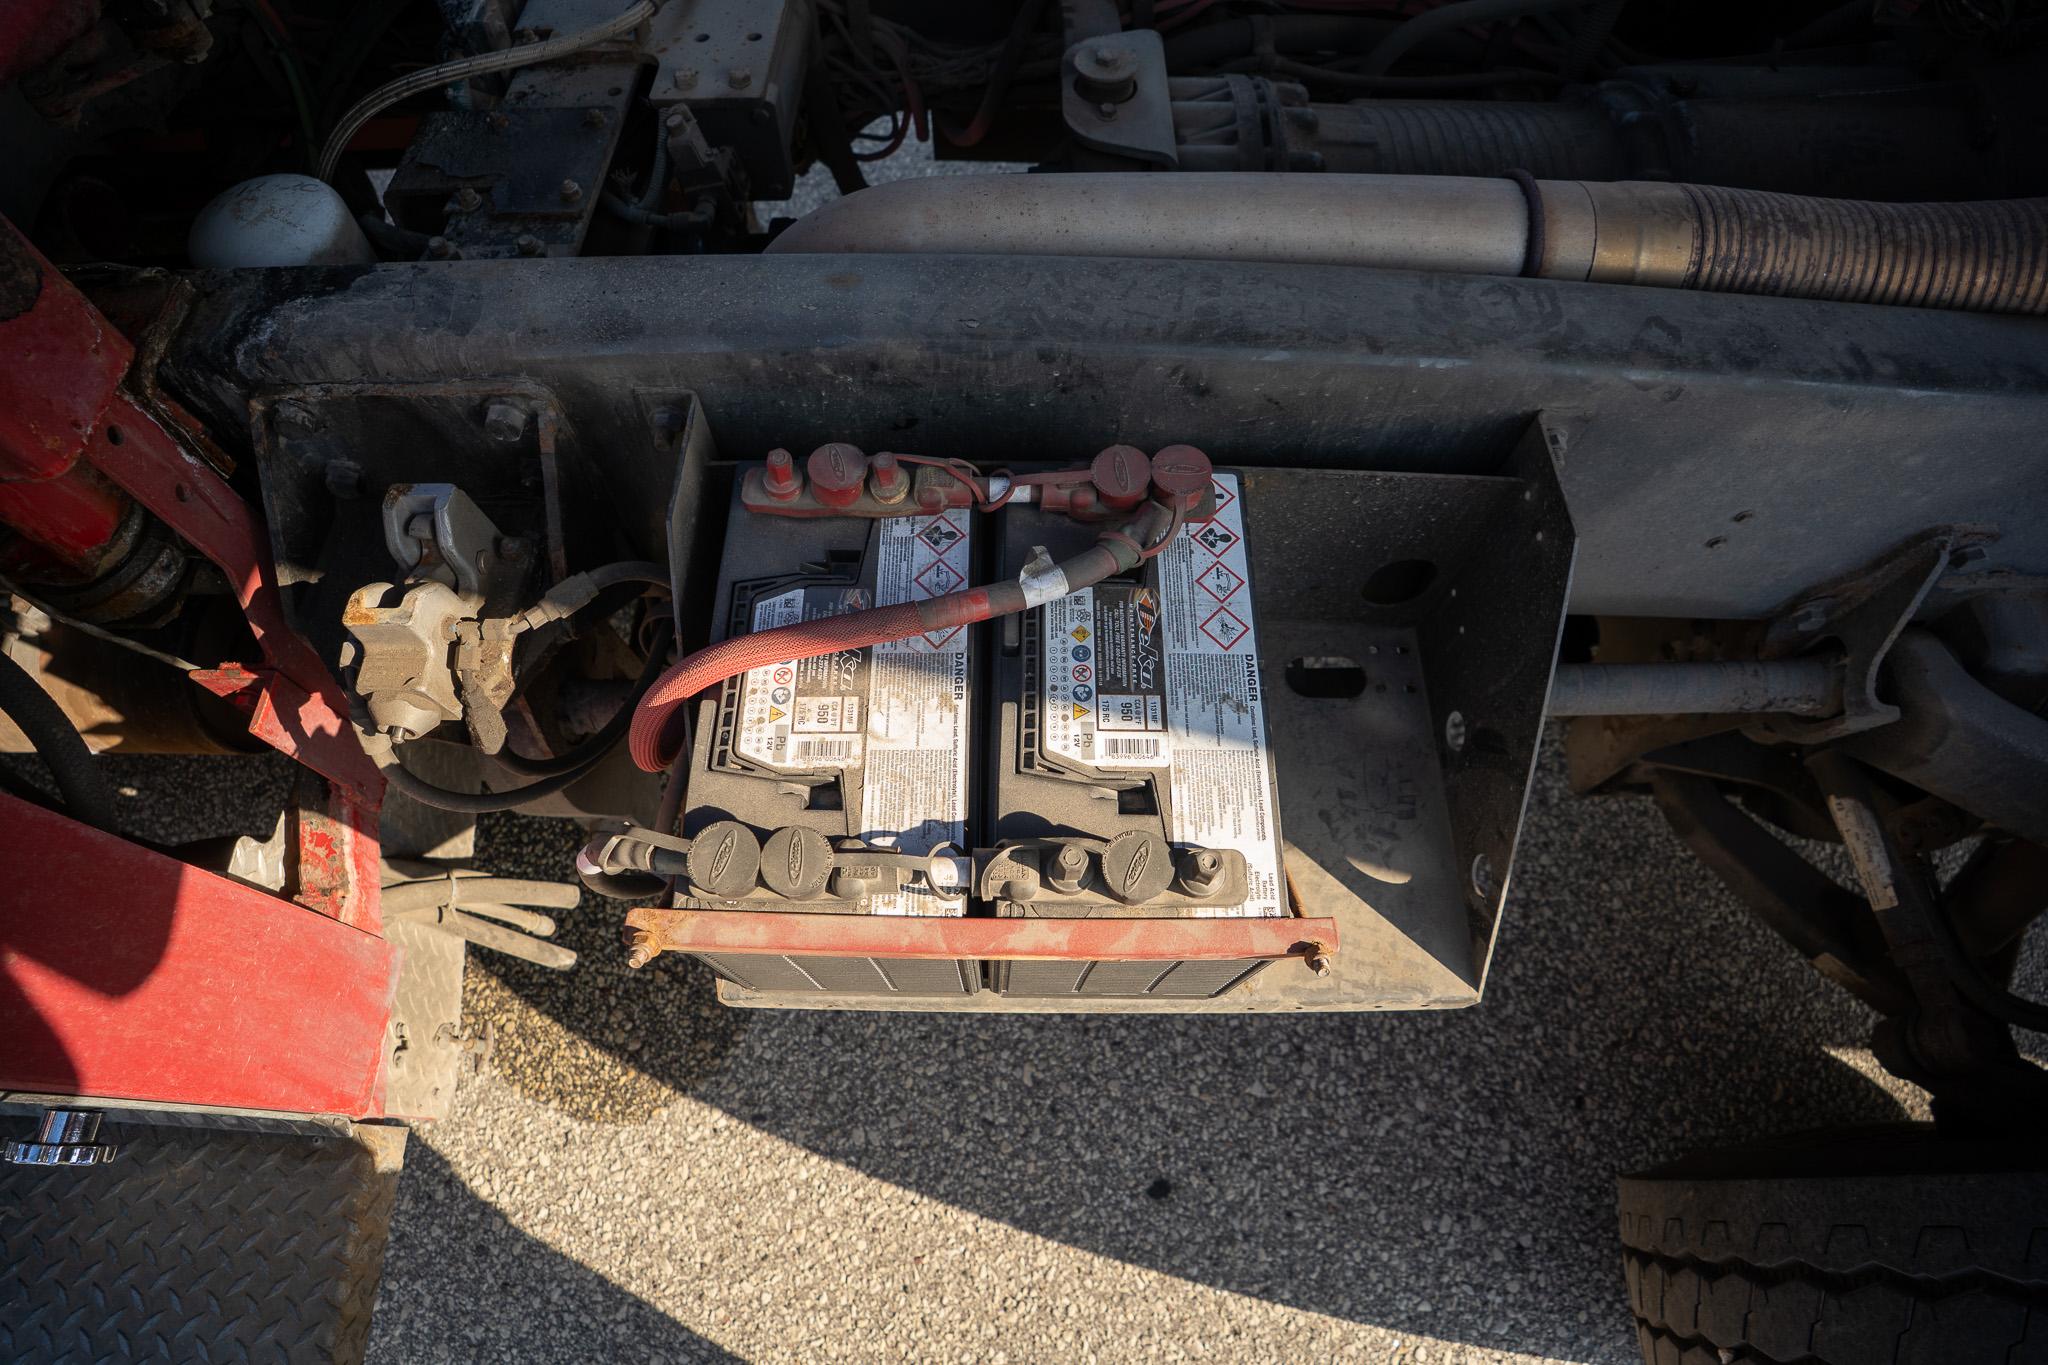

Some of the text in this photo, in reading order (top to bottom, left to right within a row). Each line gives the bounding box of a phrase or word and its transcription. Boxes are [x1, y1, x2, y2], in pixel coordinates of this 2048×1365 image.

[1137, 592, 1161, 688] Deka
[954, 652, 964, 701] DANGER
[797, 716, 806, 725] RC
[817, 705, 829, 724] 950
[1101, 700, 1110, 723] 175 RC
[1120, 701, 1133, 721] 950
[1150, 701, 1158, 723] 1131MF
[775, 736, 786, 751] Pb
[1083, 732, 1093, 747] Pb
[1245, 654, 1257, 701] DANGER
[1258, 812, 1266, 840] Compounds
[1253, 871, 1262, 899] Electrolyte
